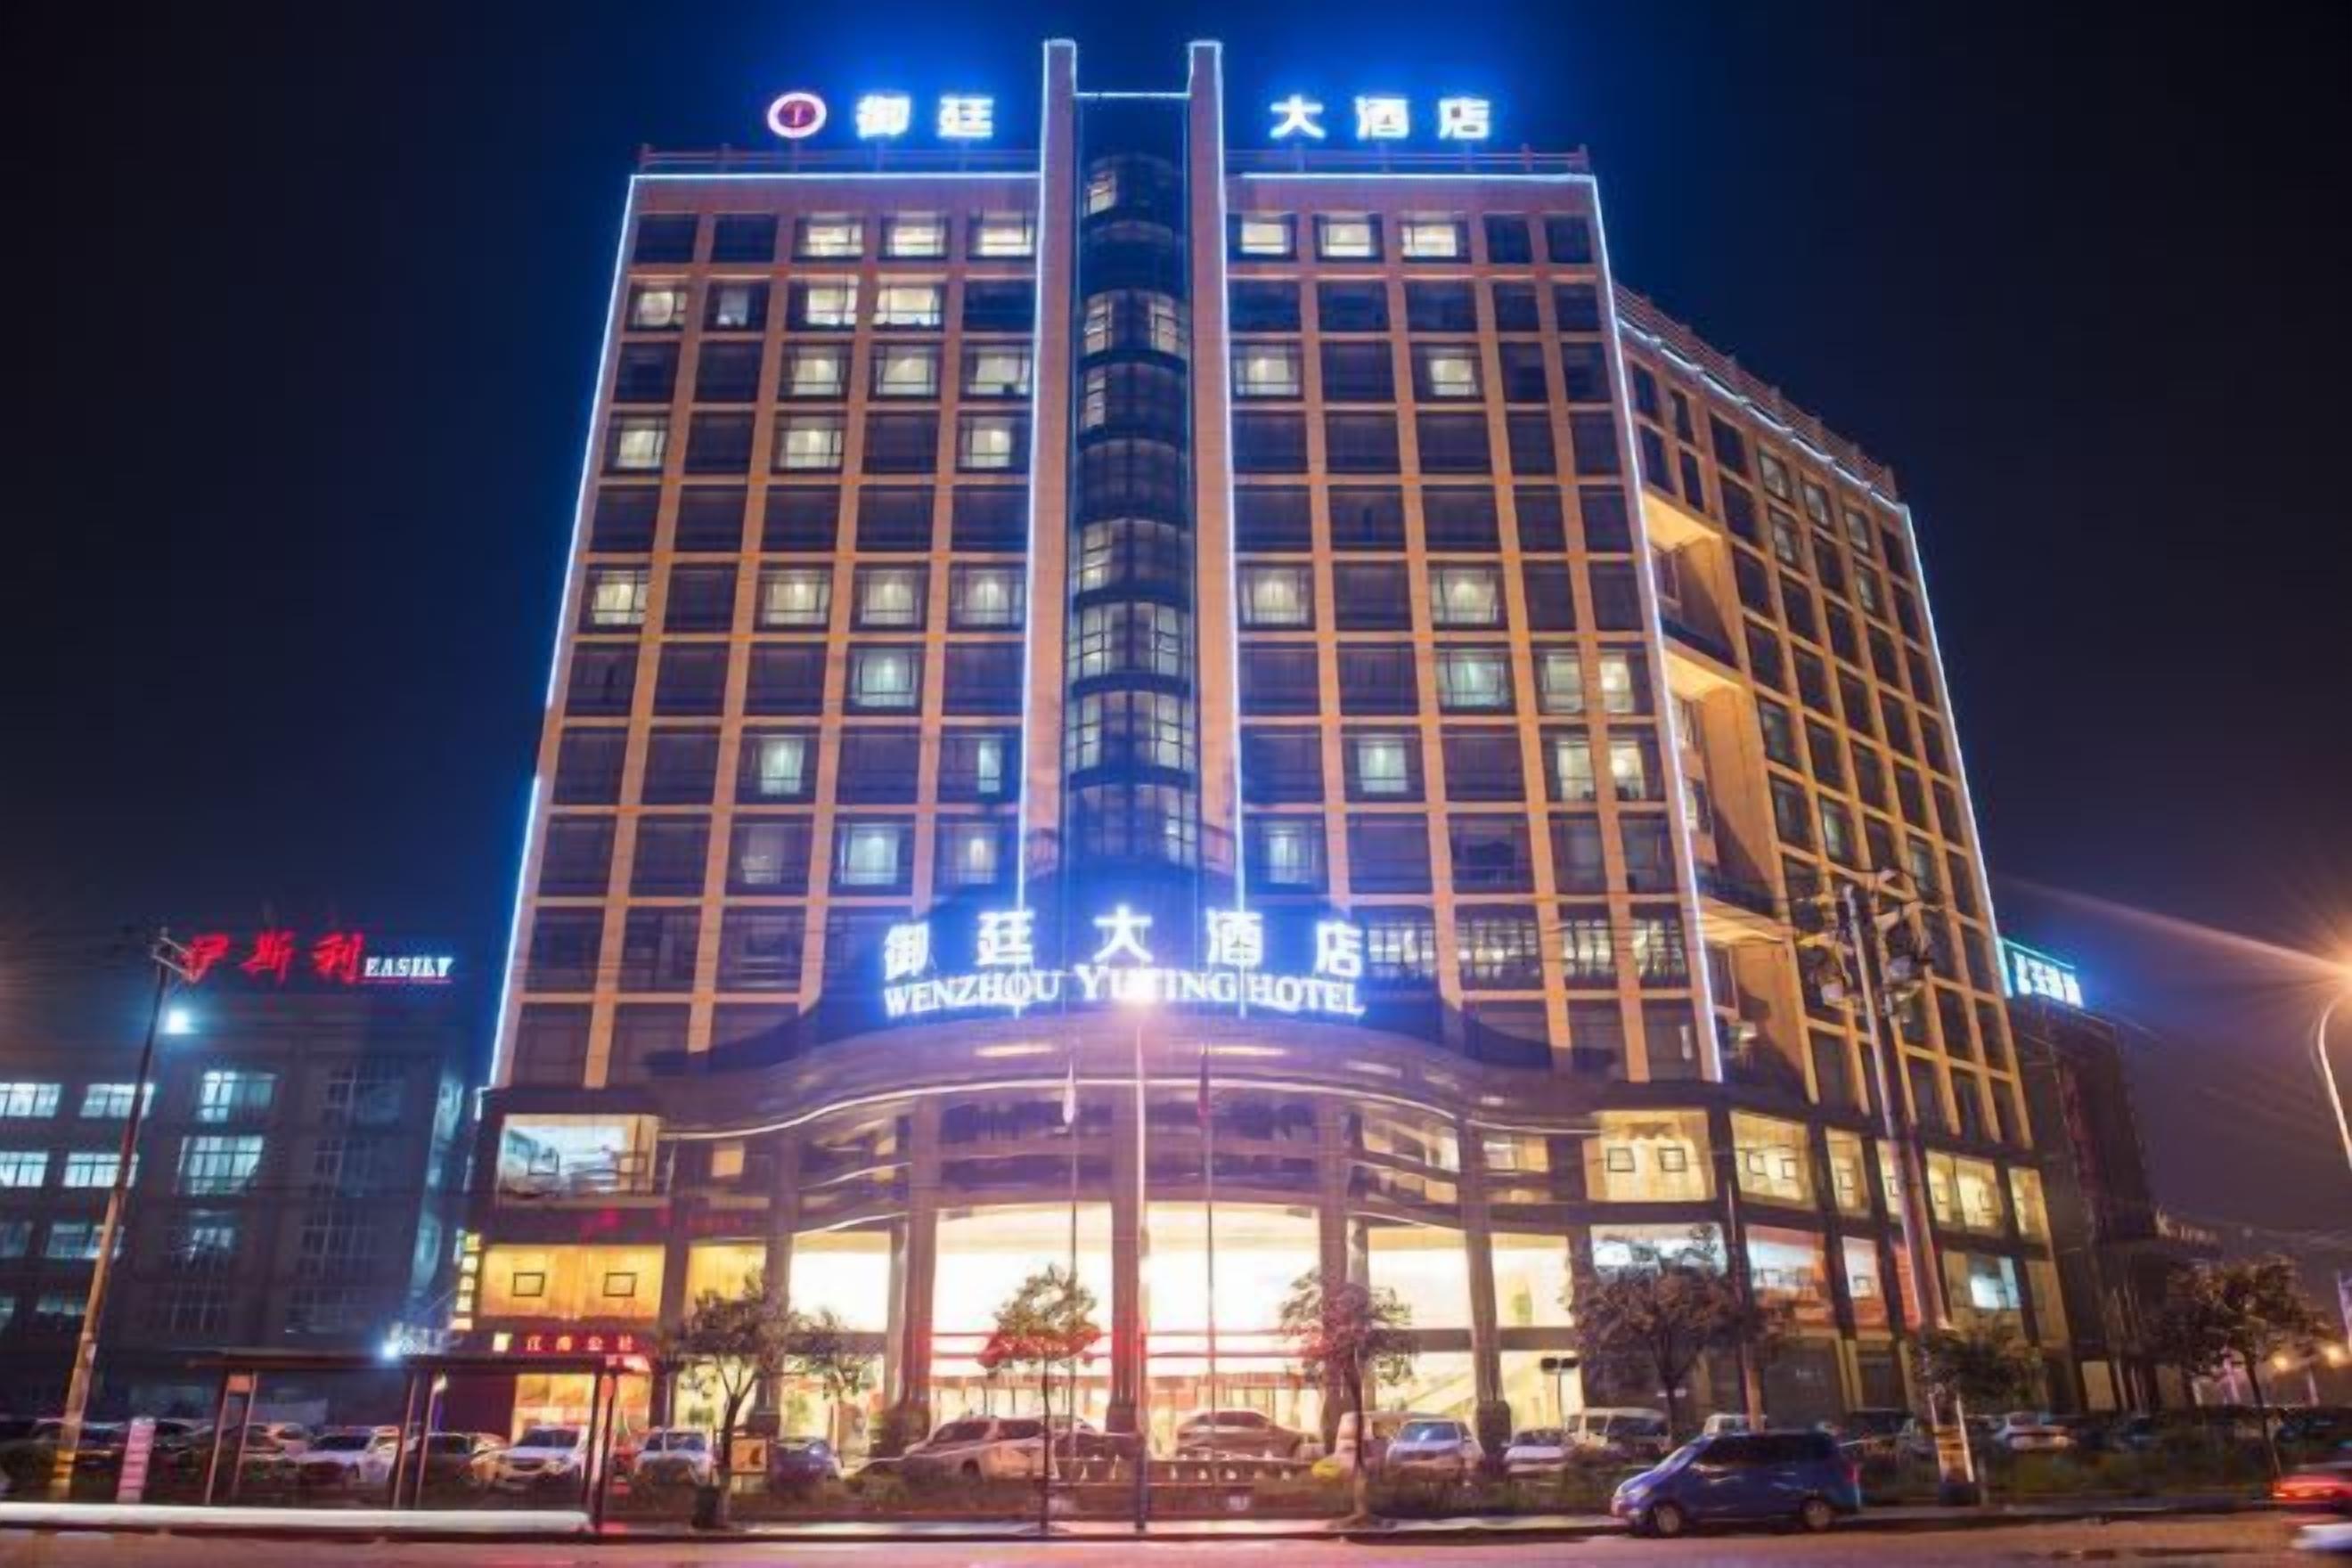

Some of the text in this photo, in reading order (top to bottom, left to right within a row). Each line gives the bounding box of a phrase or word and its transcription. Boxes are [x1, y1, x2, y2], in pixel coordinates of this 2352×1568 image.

[856, 94, 1490, 139] 御廷 大酒店
[364, 957, 453, 978] EASILY
[885, 907, 1362, 979] 御廷大酒店
[885, 963, 1365, 1017] WENZHOU YUING HOTEL
